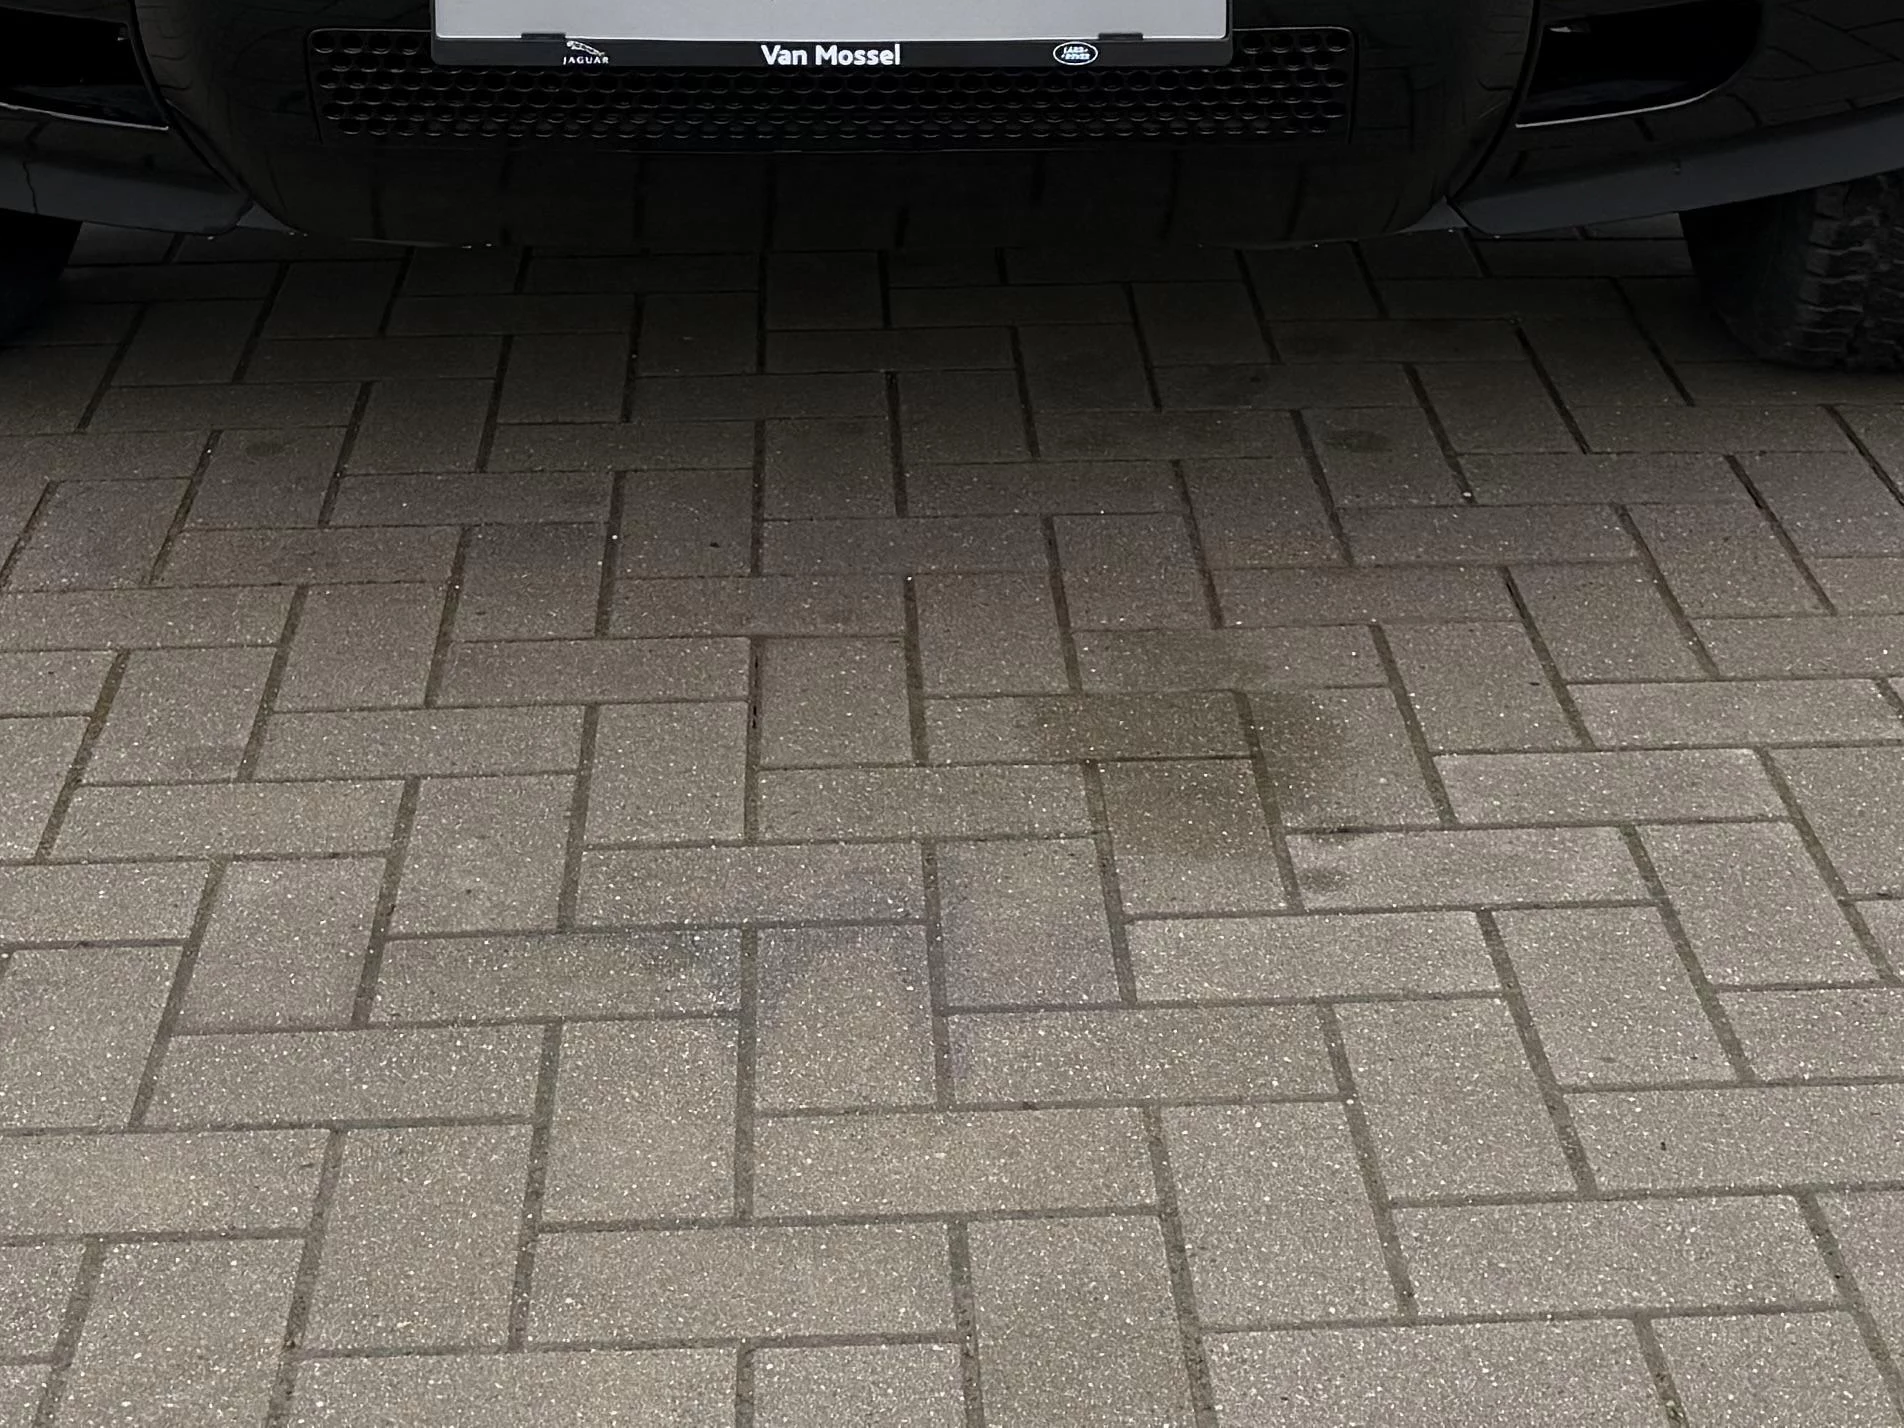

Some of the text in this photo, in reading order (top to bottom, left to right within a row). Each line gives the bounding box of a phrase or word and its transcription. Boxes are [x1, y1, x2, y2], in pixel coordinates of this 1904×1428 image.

[562, 56, 609, 66] JAGUAR
[760, 43, 901, 66] Van Mossel
